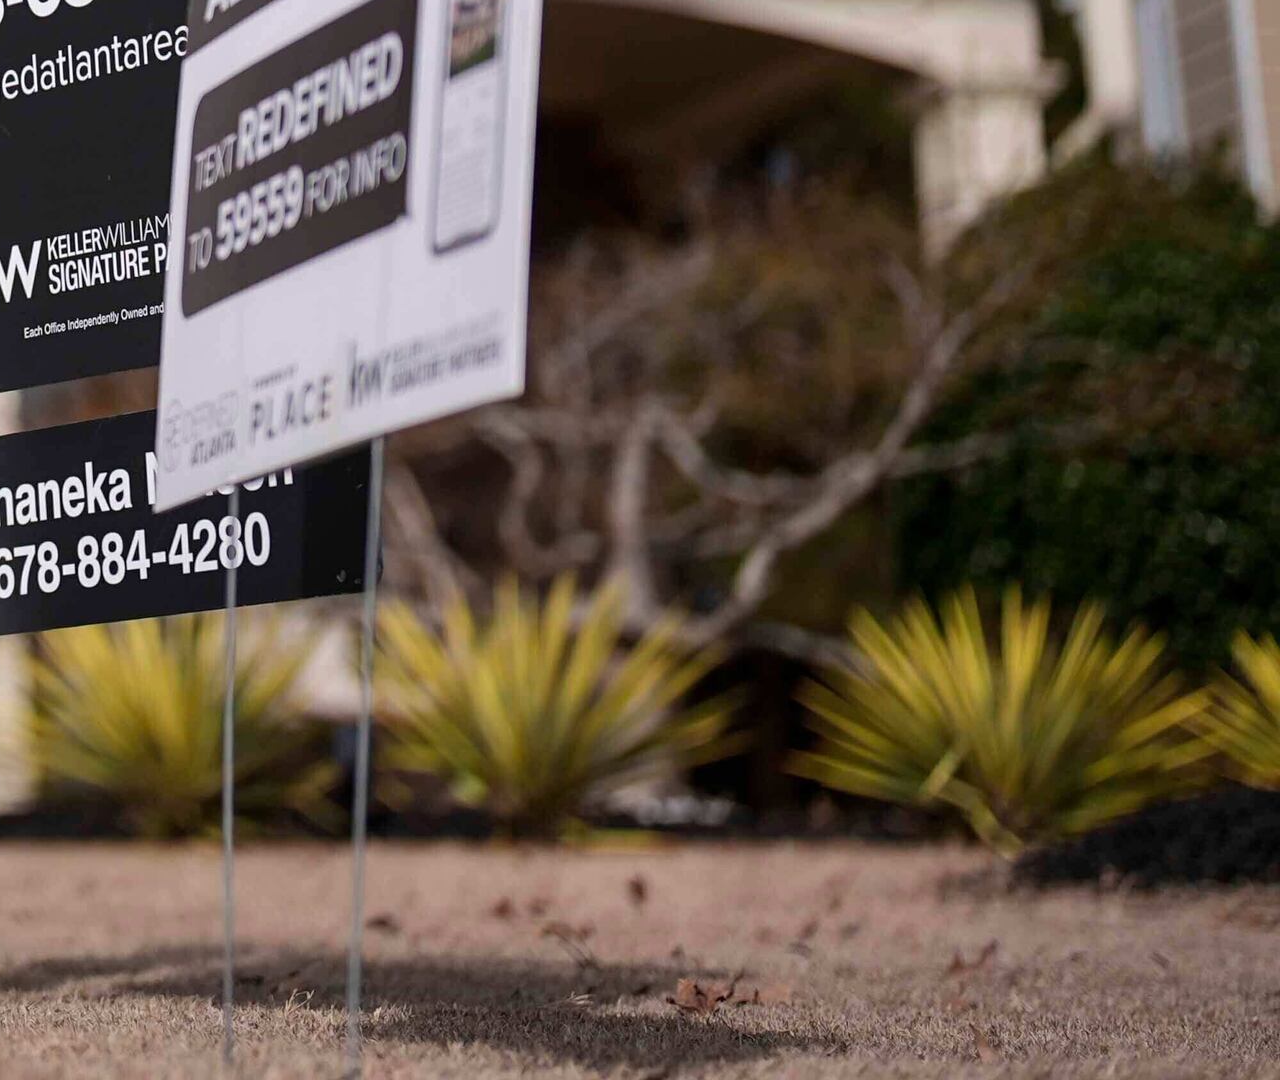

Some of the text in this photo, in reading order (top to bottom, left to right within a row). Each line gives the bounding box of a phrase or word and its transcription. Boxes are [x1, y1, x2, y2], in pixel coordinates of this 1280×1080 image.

[194, 30, 403, 193] TEXT REDEFINED
[189, 226, 213, 273] TO
[215, 165, 305, 261] 59559
[305, 159, 350, 218] FOR
[349, 131, 407, 198] INFO
[47, 213, 172, 261] KELLERWILLIAM
[48, 245, 151, 295] SIGNATURE
[24, 302, 165, 340] Each Office Independently Owned and
[250, 374, 333, 446] PLACE
